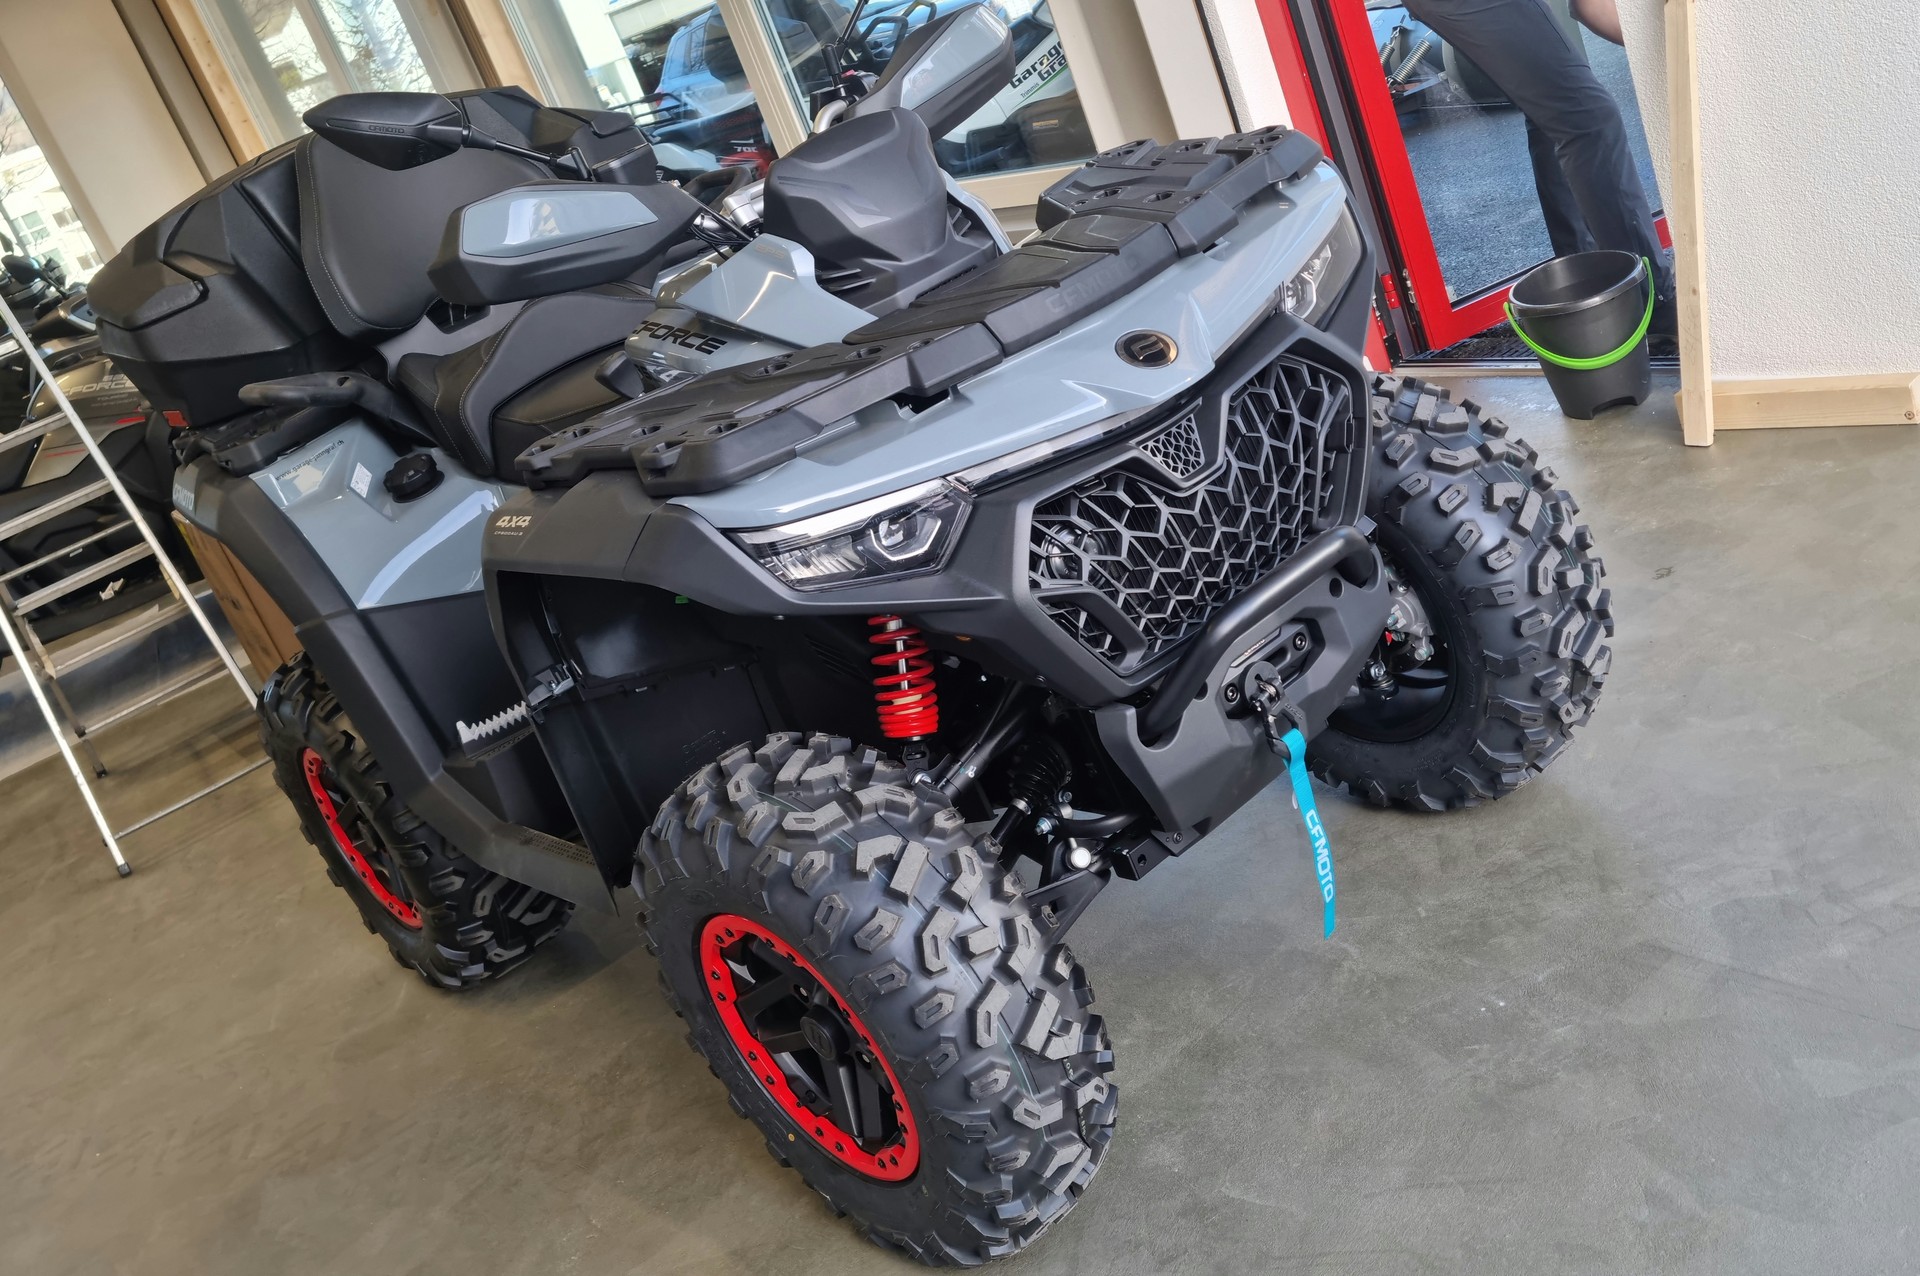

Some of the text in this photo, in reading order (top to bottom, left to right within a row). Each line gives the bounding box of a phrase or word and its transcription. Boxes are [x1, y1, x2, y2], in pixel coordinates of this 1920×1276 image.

[1045, 253, 1139, 314] CFMOTO
[275, 439, 345, 481] www.garage-janngraf.ch
[1305, 808, 1334, 903] CFMOTO
